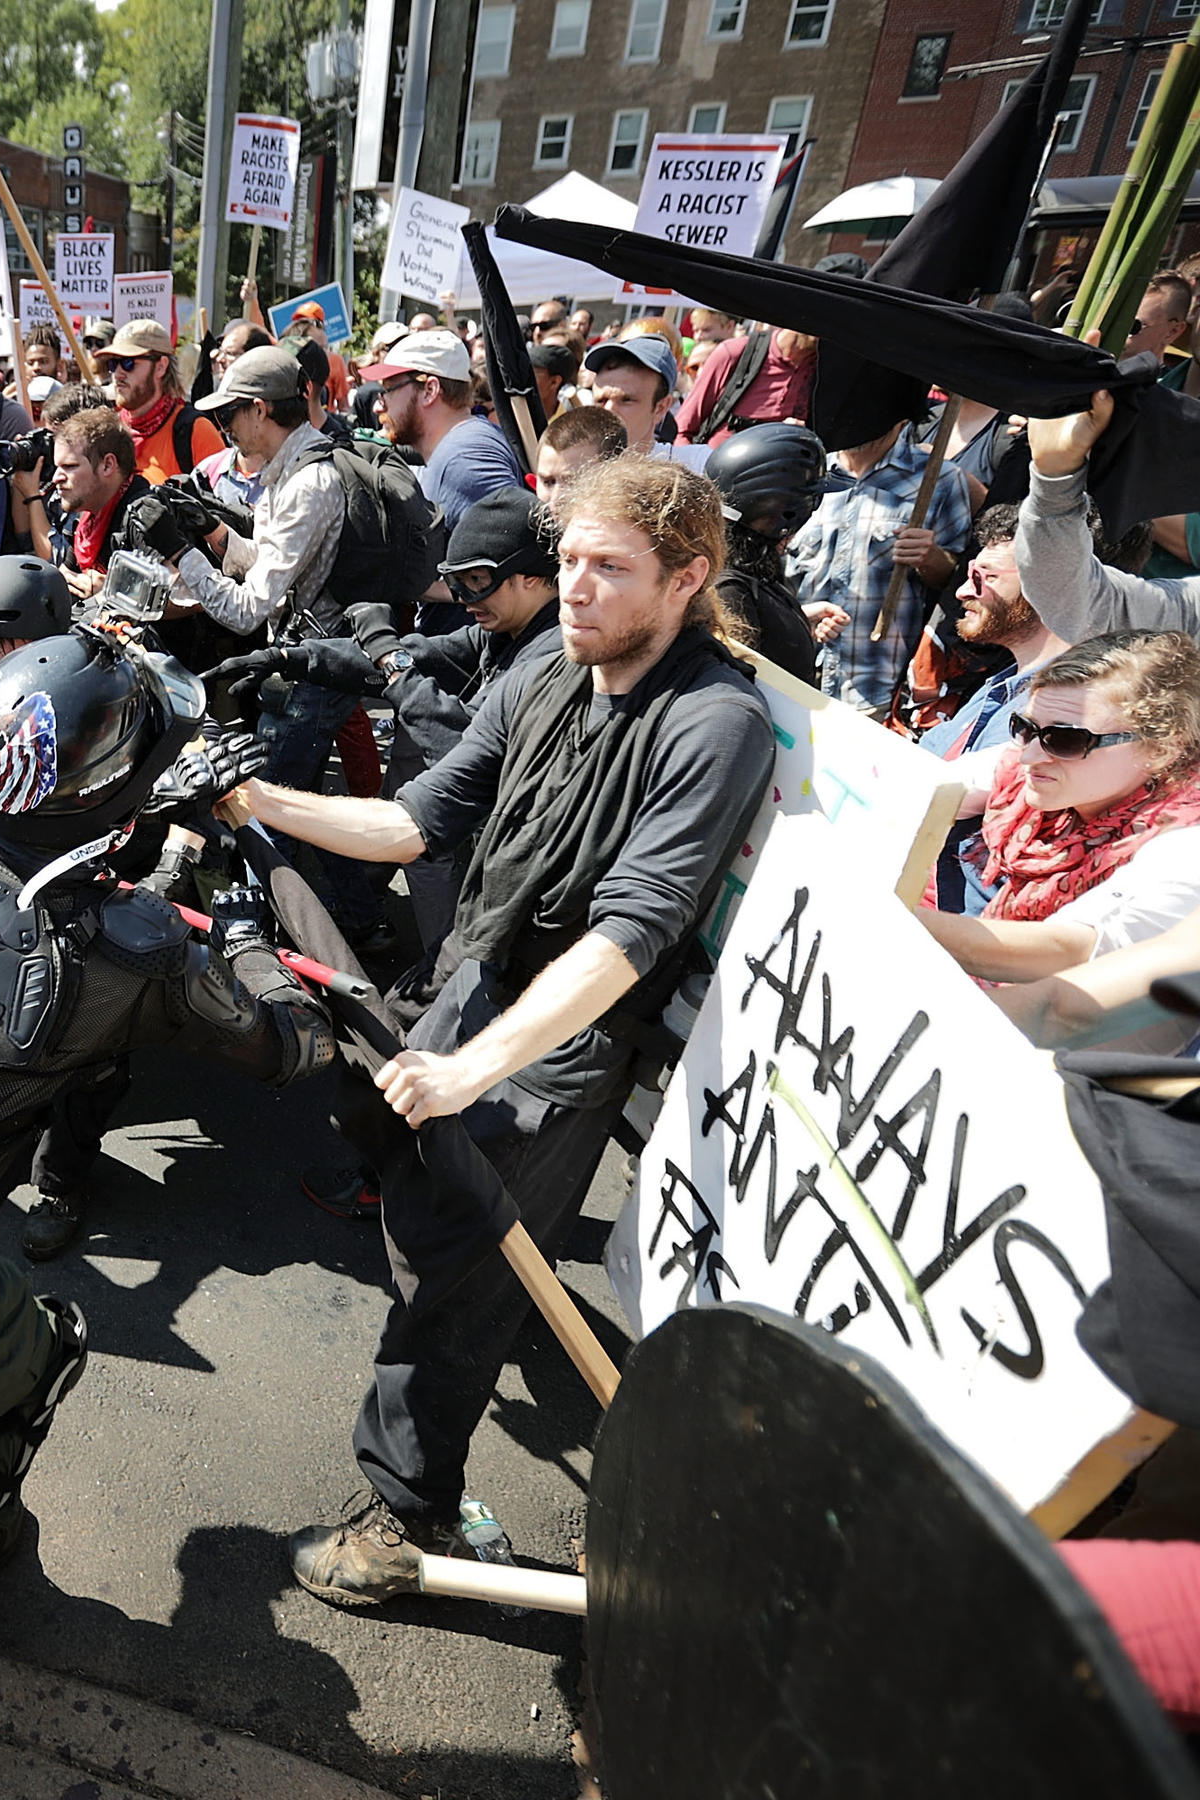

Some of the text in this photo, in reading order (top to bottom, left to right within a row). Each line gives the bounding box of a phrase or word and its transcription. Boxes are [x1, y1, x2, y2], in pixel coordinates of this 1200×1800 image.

[251, 134, 285, 152] MAKE
[241, 150, 289, 172] RACISTS
[658, 160, 766, 182] KESSLER IS
[243, 170, 286, 190] AFRAID
[244, 189, 282, 207] AGAIN
[657, 193, 748, 215] A RACIST
[292, 162, 313, 283] Downtown Mall
[410, 201, 460, 234] General
[406, 220, 455, 251] Sherman
[664, 224, 728, 246] SEWER
[63, 242, 106, 257] BLACK
[66, 260, 102, 275] LIVES
[399, 250, 444, 284] Nothing
[61, 279, 108, 293] MATTER
[120, 283, 166, 295] KKKESSLER
[403, 271, 437, 300] Wrong
[27, 305, 54, 318] RACIS
[138, 298, 157, 307] NAZI
[70, 840, 108, 861] UNDER
[741, 886, 1088, 1380] ALWAYS
